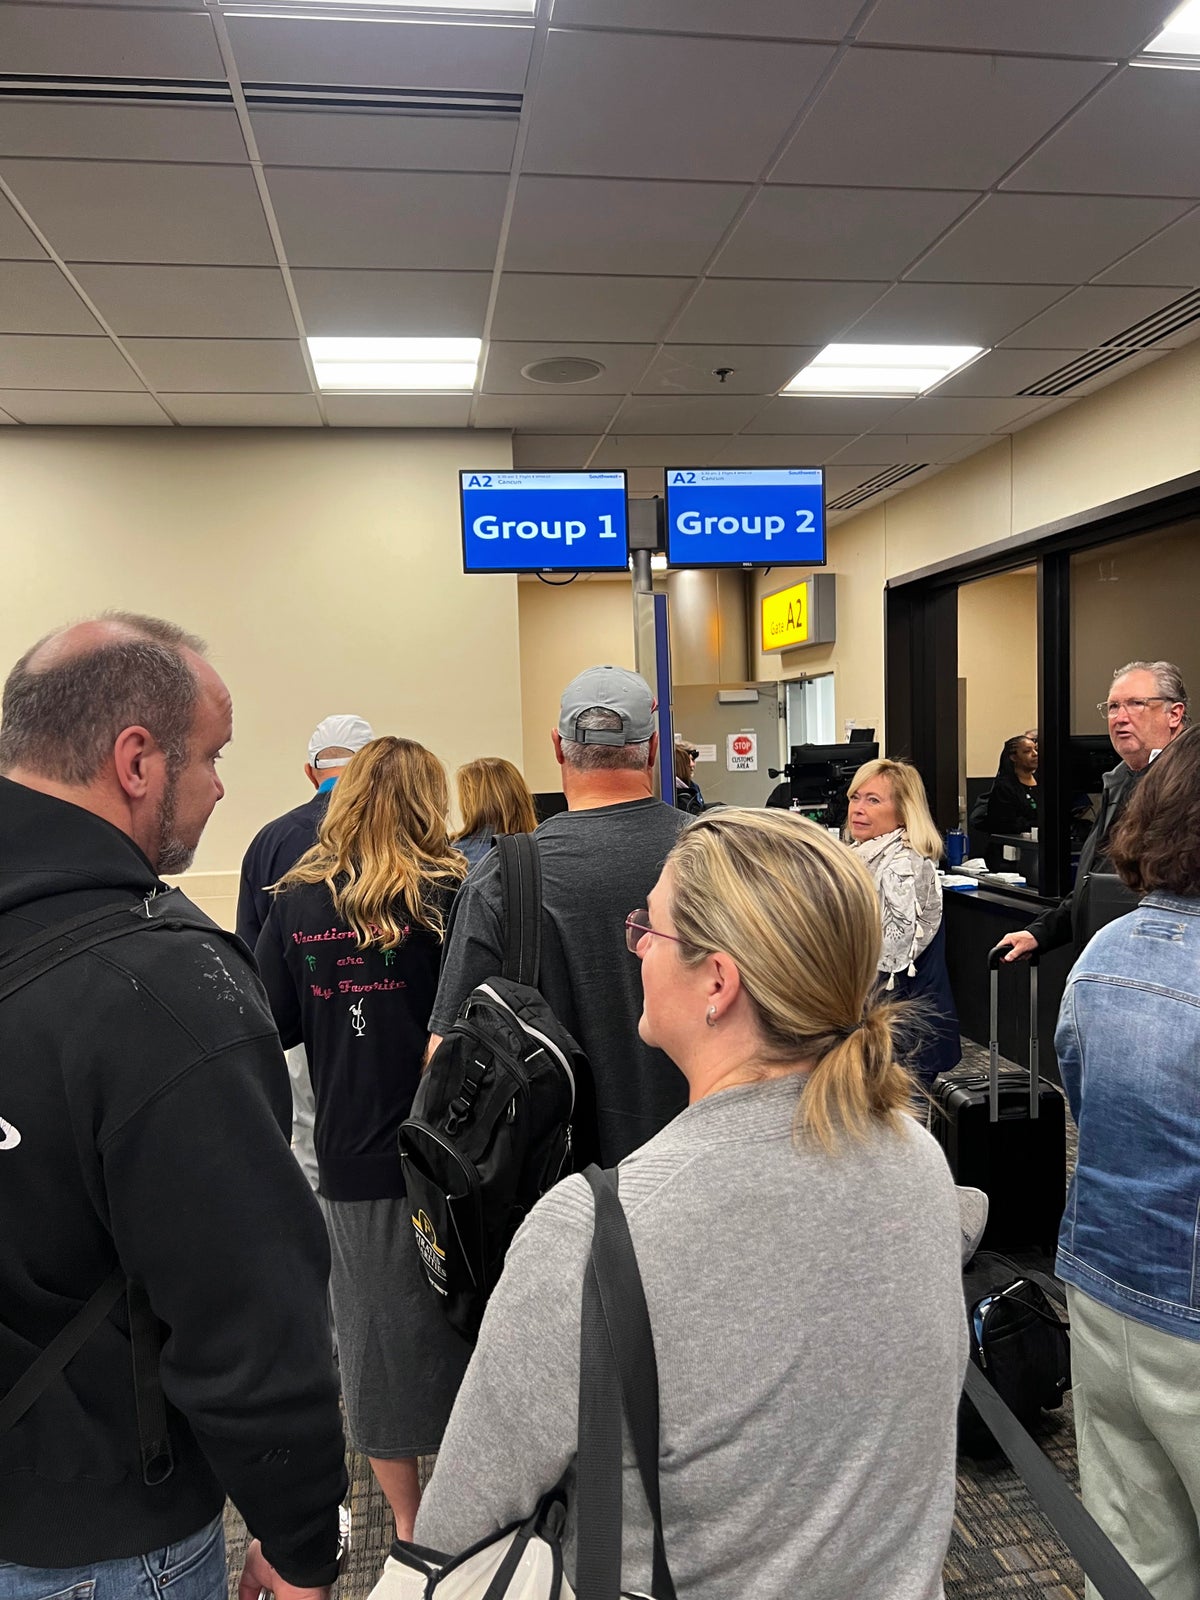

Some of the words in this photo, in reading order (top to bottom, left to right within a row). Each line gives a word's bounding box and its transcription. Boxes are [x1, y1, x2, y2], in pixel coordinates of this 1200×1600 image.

[468, 475, 493, 487] A2
[673, 472, 697, 484] A2
[472, 515, 587, 545] Group
[598, 514, 617, 538] 1
[676, 511, 786, 540] Group
[795, 509, 816, 533] 2
[770, 621, 784, 635] Gate
[786, 598, 802, 631] A2
[734, 741, 751, 750] STOP
[337, 956, 365, 966] are
[310, 984, 334, 1000] My
[338, 979, 407, 993] Favorite
